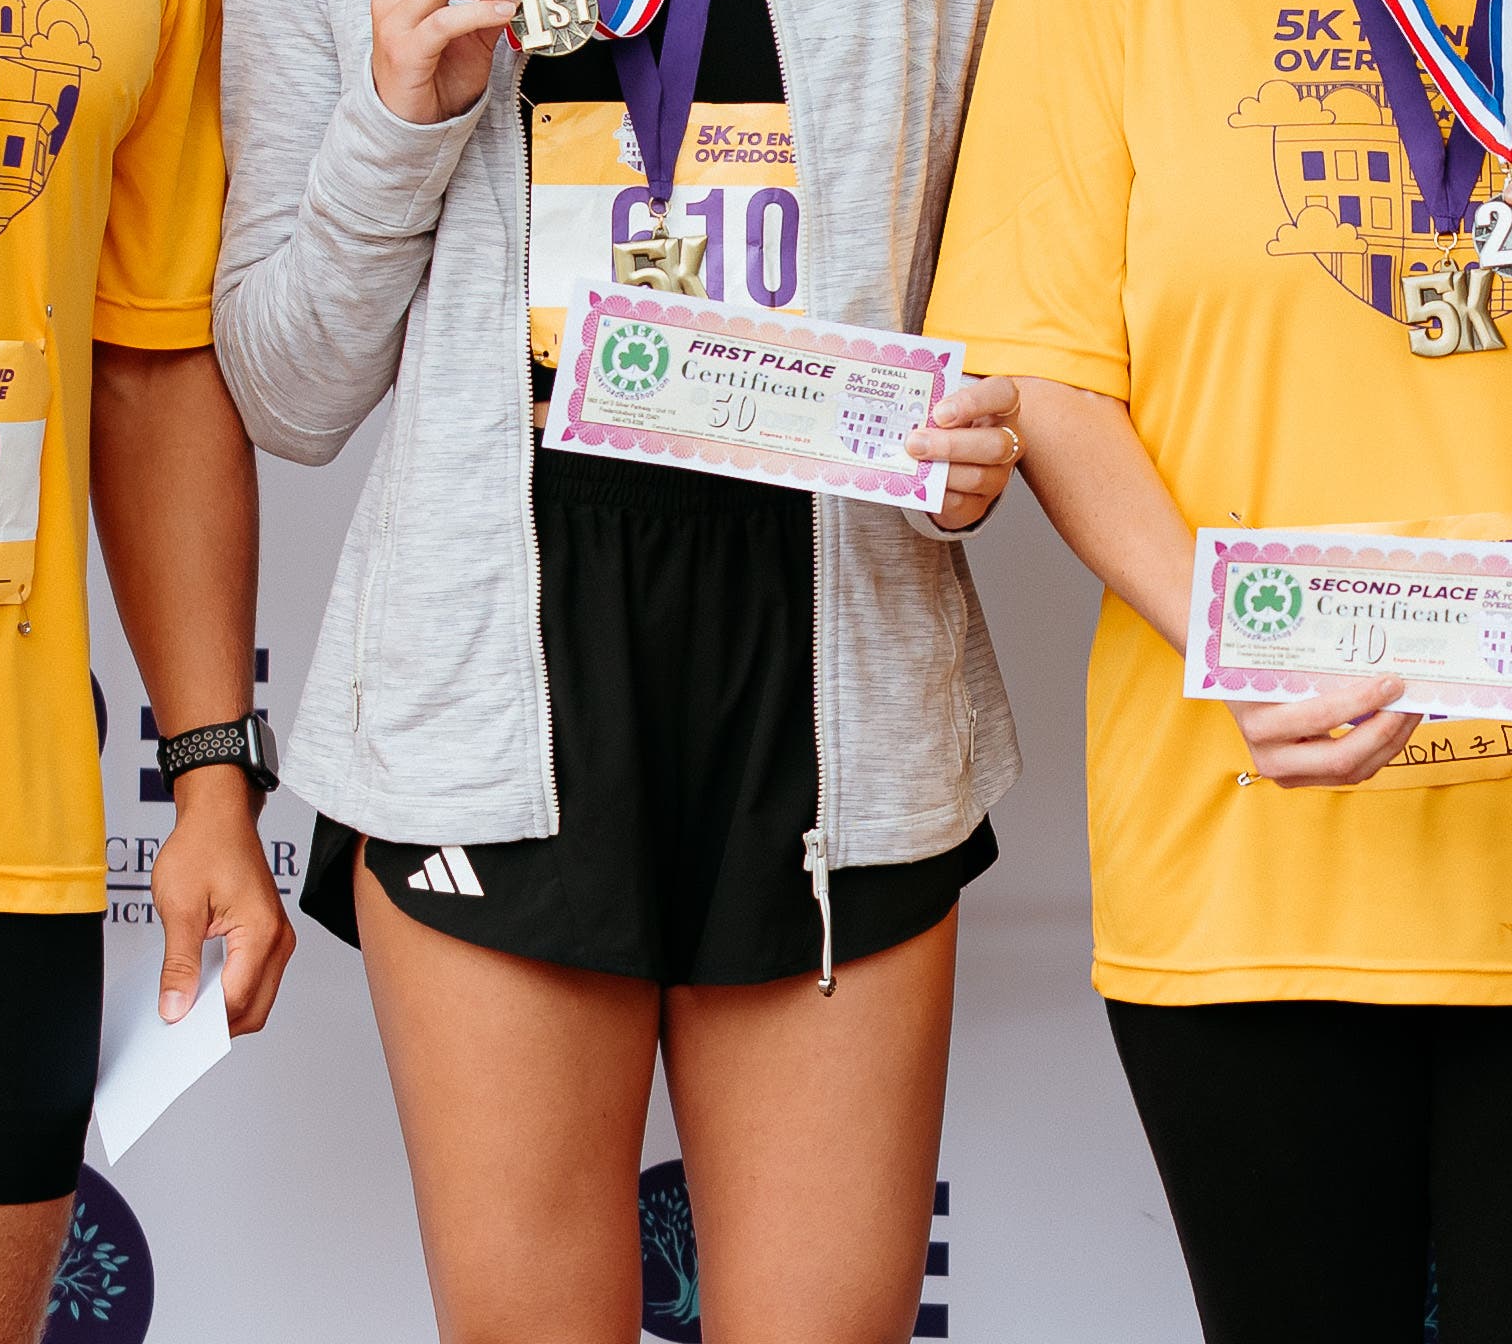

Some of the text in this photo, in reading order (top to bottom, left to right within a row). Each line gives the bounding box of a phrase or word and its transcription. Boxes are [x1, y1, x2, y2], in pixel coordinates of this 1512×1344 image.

[1273, 8, 1346, 41] 5K
[697, 125, 793, 147] 5K TO EN
[1400, 267, 1507, 357] 5K
[689, 340, 757, 363] FIRST
[759, 353, 836, 379] PLACE
[871, 367, 908, 379] OVERALL
[681, 359, 826, 404] Certificate
[844, 383, 896, 400] OVERDOSE
[847, 372, 867, 385] 5K
[1308, 577, 1479, 601] SECOND PLACE
[1316, 594, 1470, 625] Certificate
[1403, 737, 1456, 765] OM
